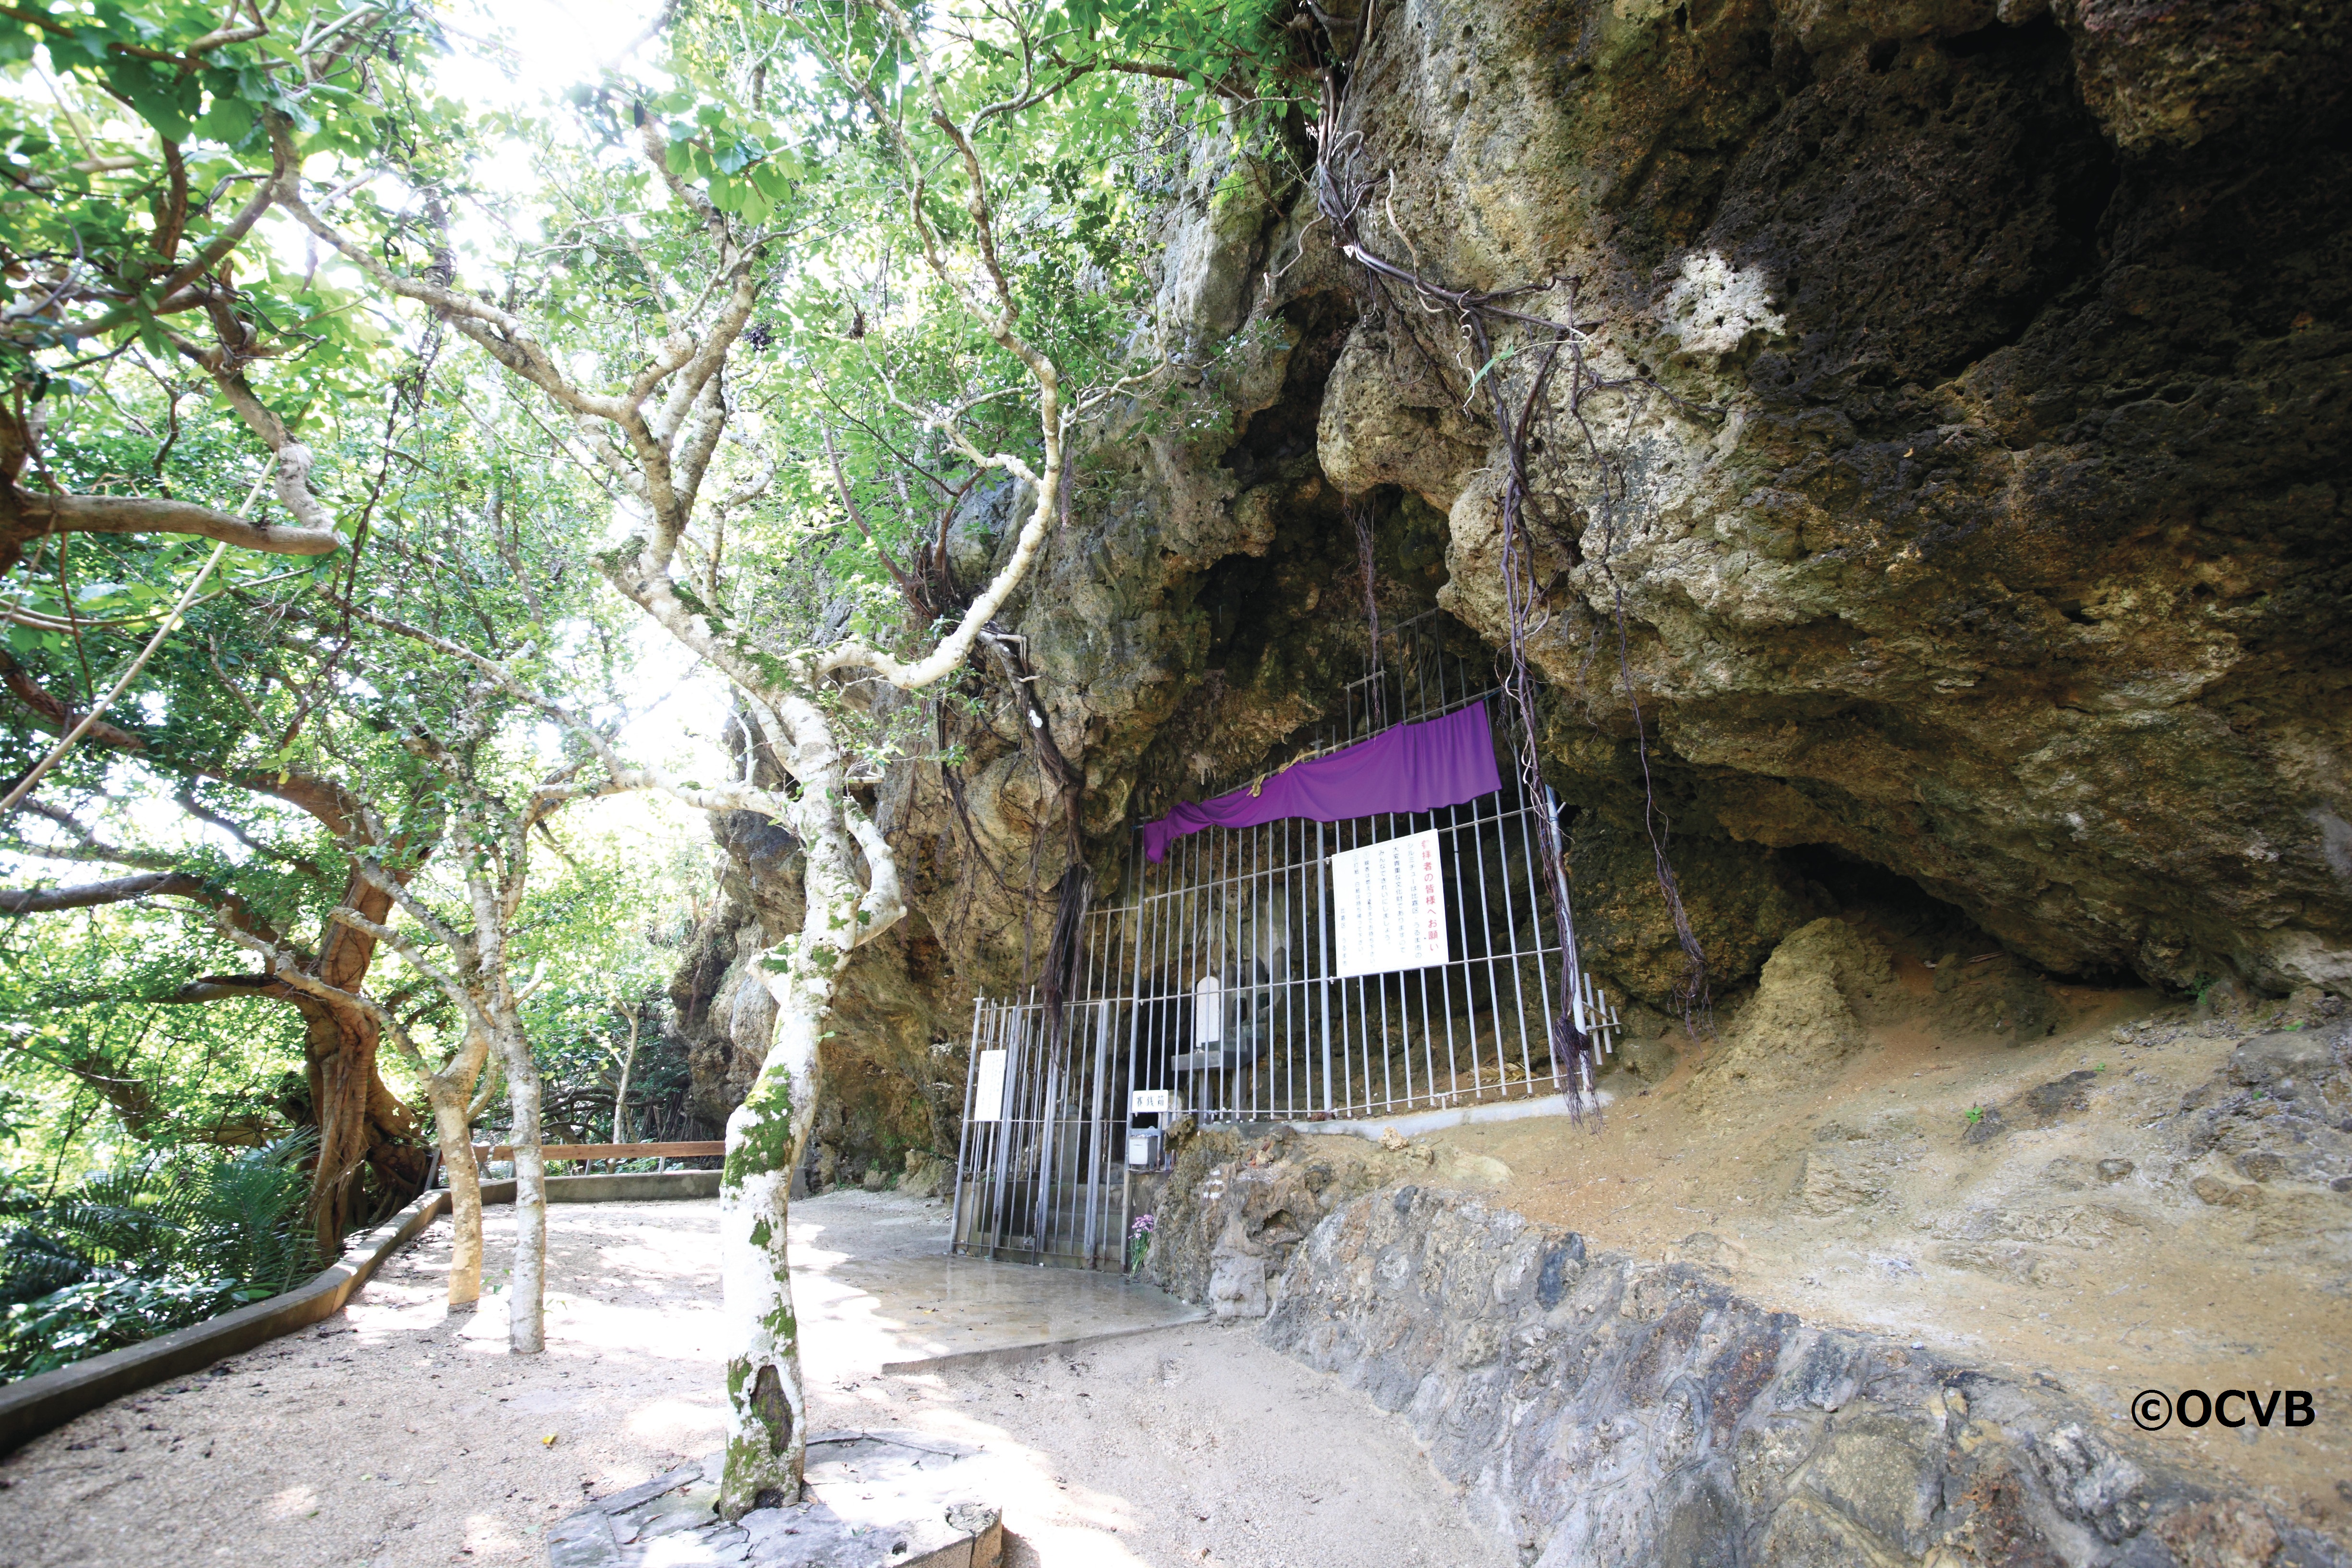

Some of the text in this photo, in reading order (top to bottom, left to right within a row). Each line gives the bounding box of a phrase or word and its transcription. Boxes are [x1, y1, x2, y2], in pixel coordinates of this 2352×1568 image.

[1379, 850, 1391, 945] みんなできれいにしましょう。
[1393, 847, 1406, 953] 大変貴重な文化財でありますので
[1137, 1095, 1164, 1107] 賽銭箱
